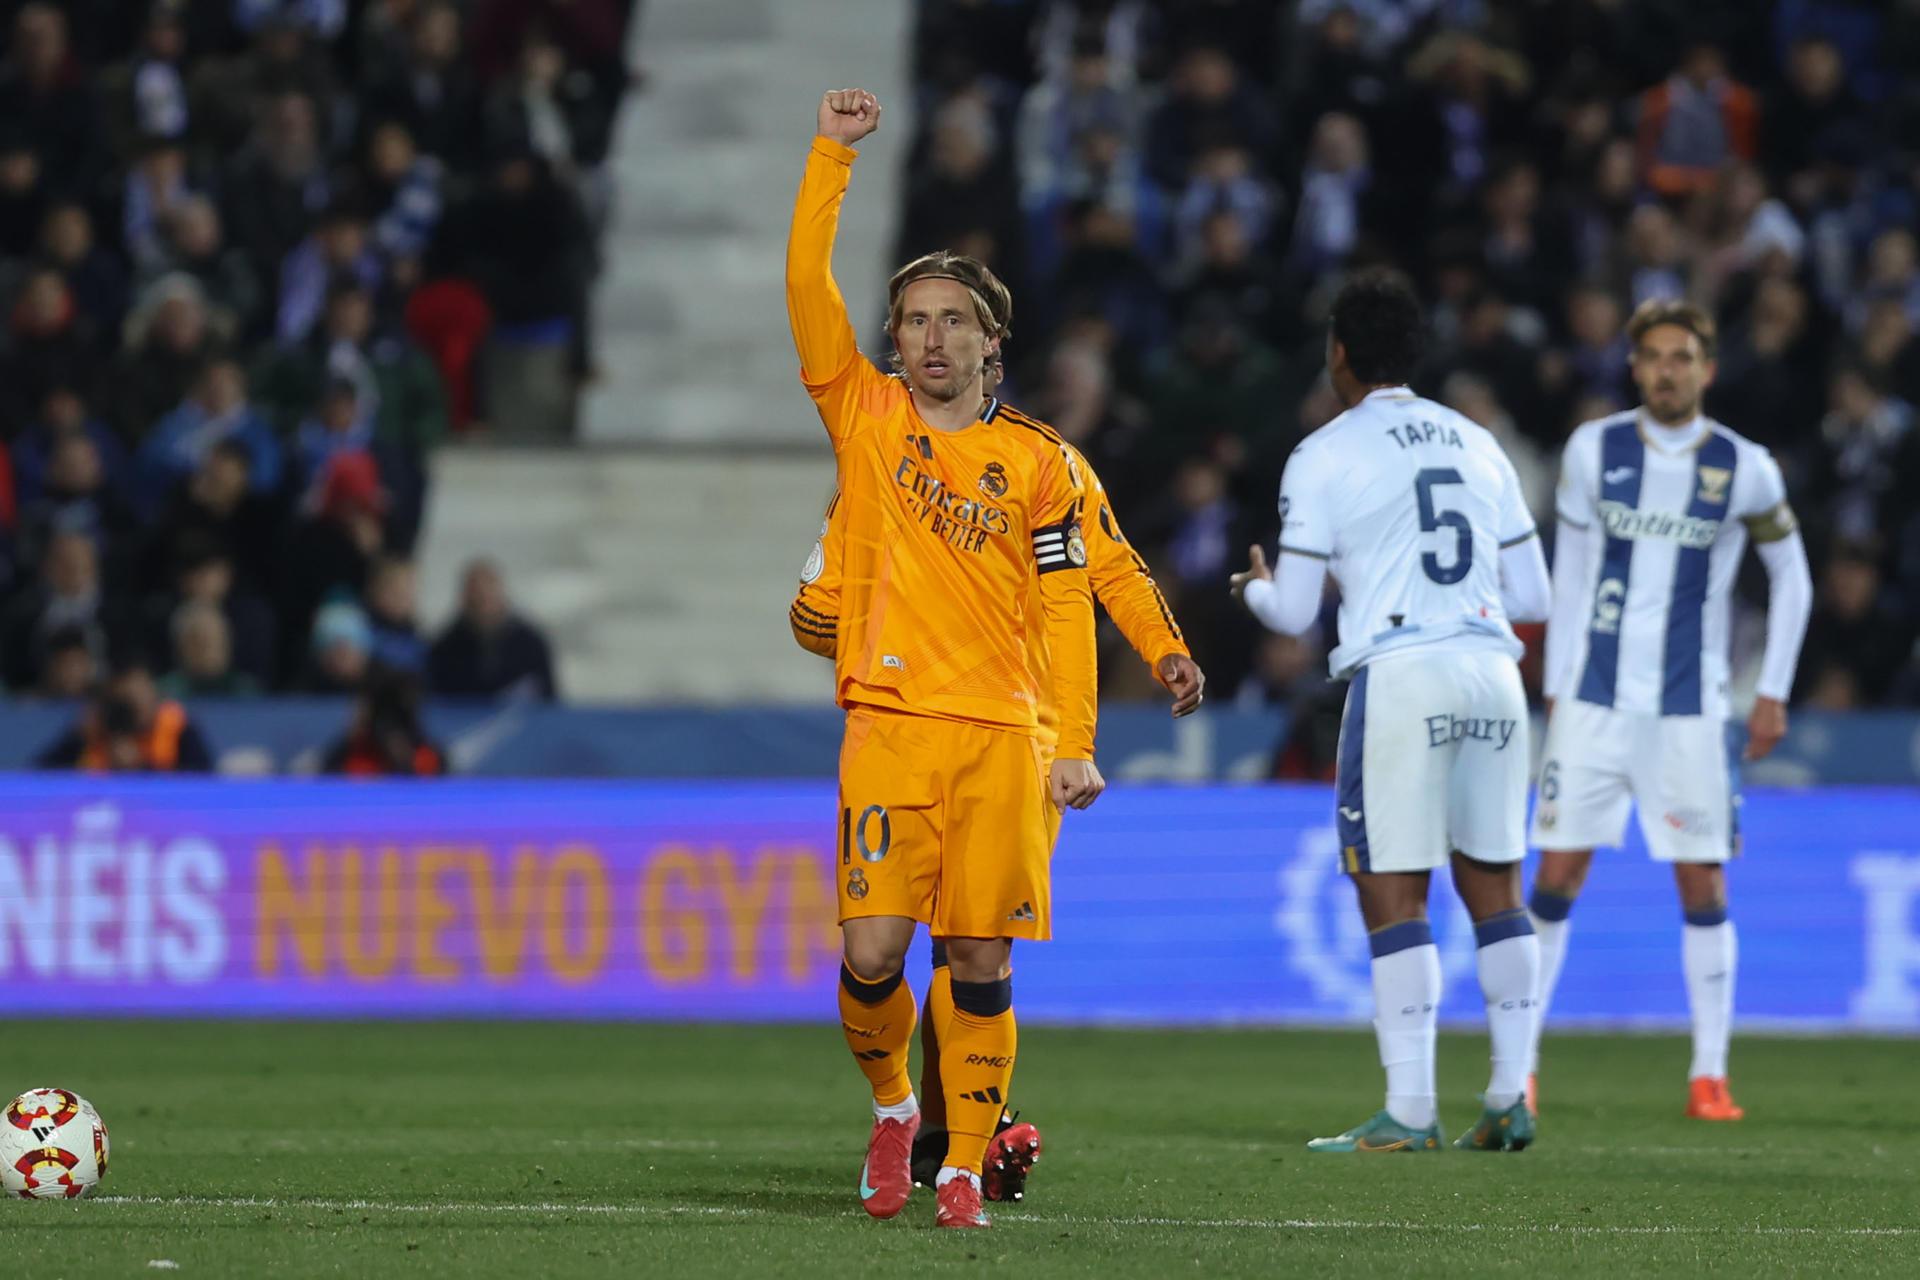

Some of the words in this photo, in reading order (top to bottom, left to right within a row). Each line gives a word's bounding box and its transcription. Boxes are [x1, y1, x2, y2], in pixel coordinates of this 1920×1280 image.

[1386, 421, 1465, 449] TAPIA
[896, 455, 1008, 534] Emirates
[931, 513, 988, 554] BETTER
[1415, 467, 1473, 585] 5
[1423, 712, 1517, 751] Ebury
[1541, 759, 1560, 801] 6
[843, 803, 891, 866] 10
[0, 801, 227, 980] NÉIS
[255, 842, 612, 980] NUEVO
[964, 1053, 1014, 1068] RMCF
